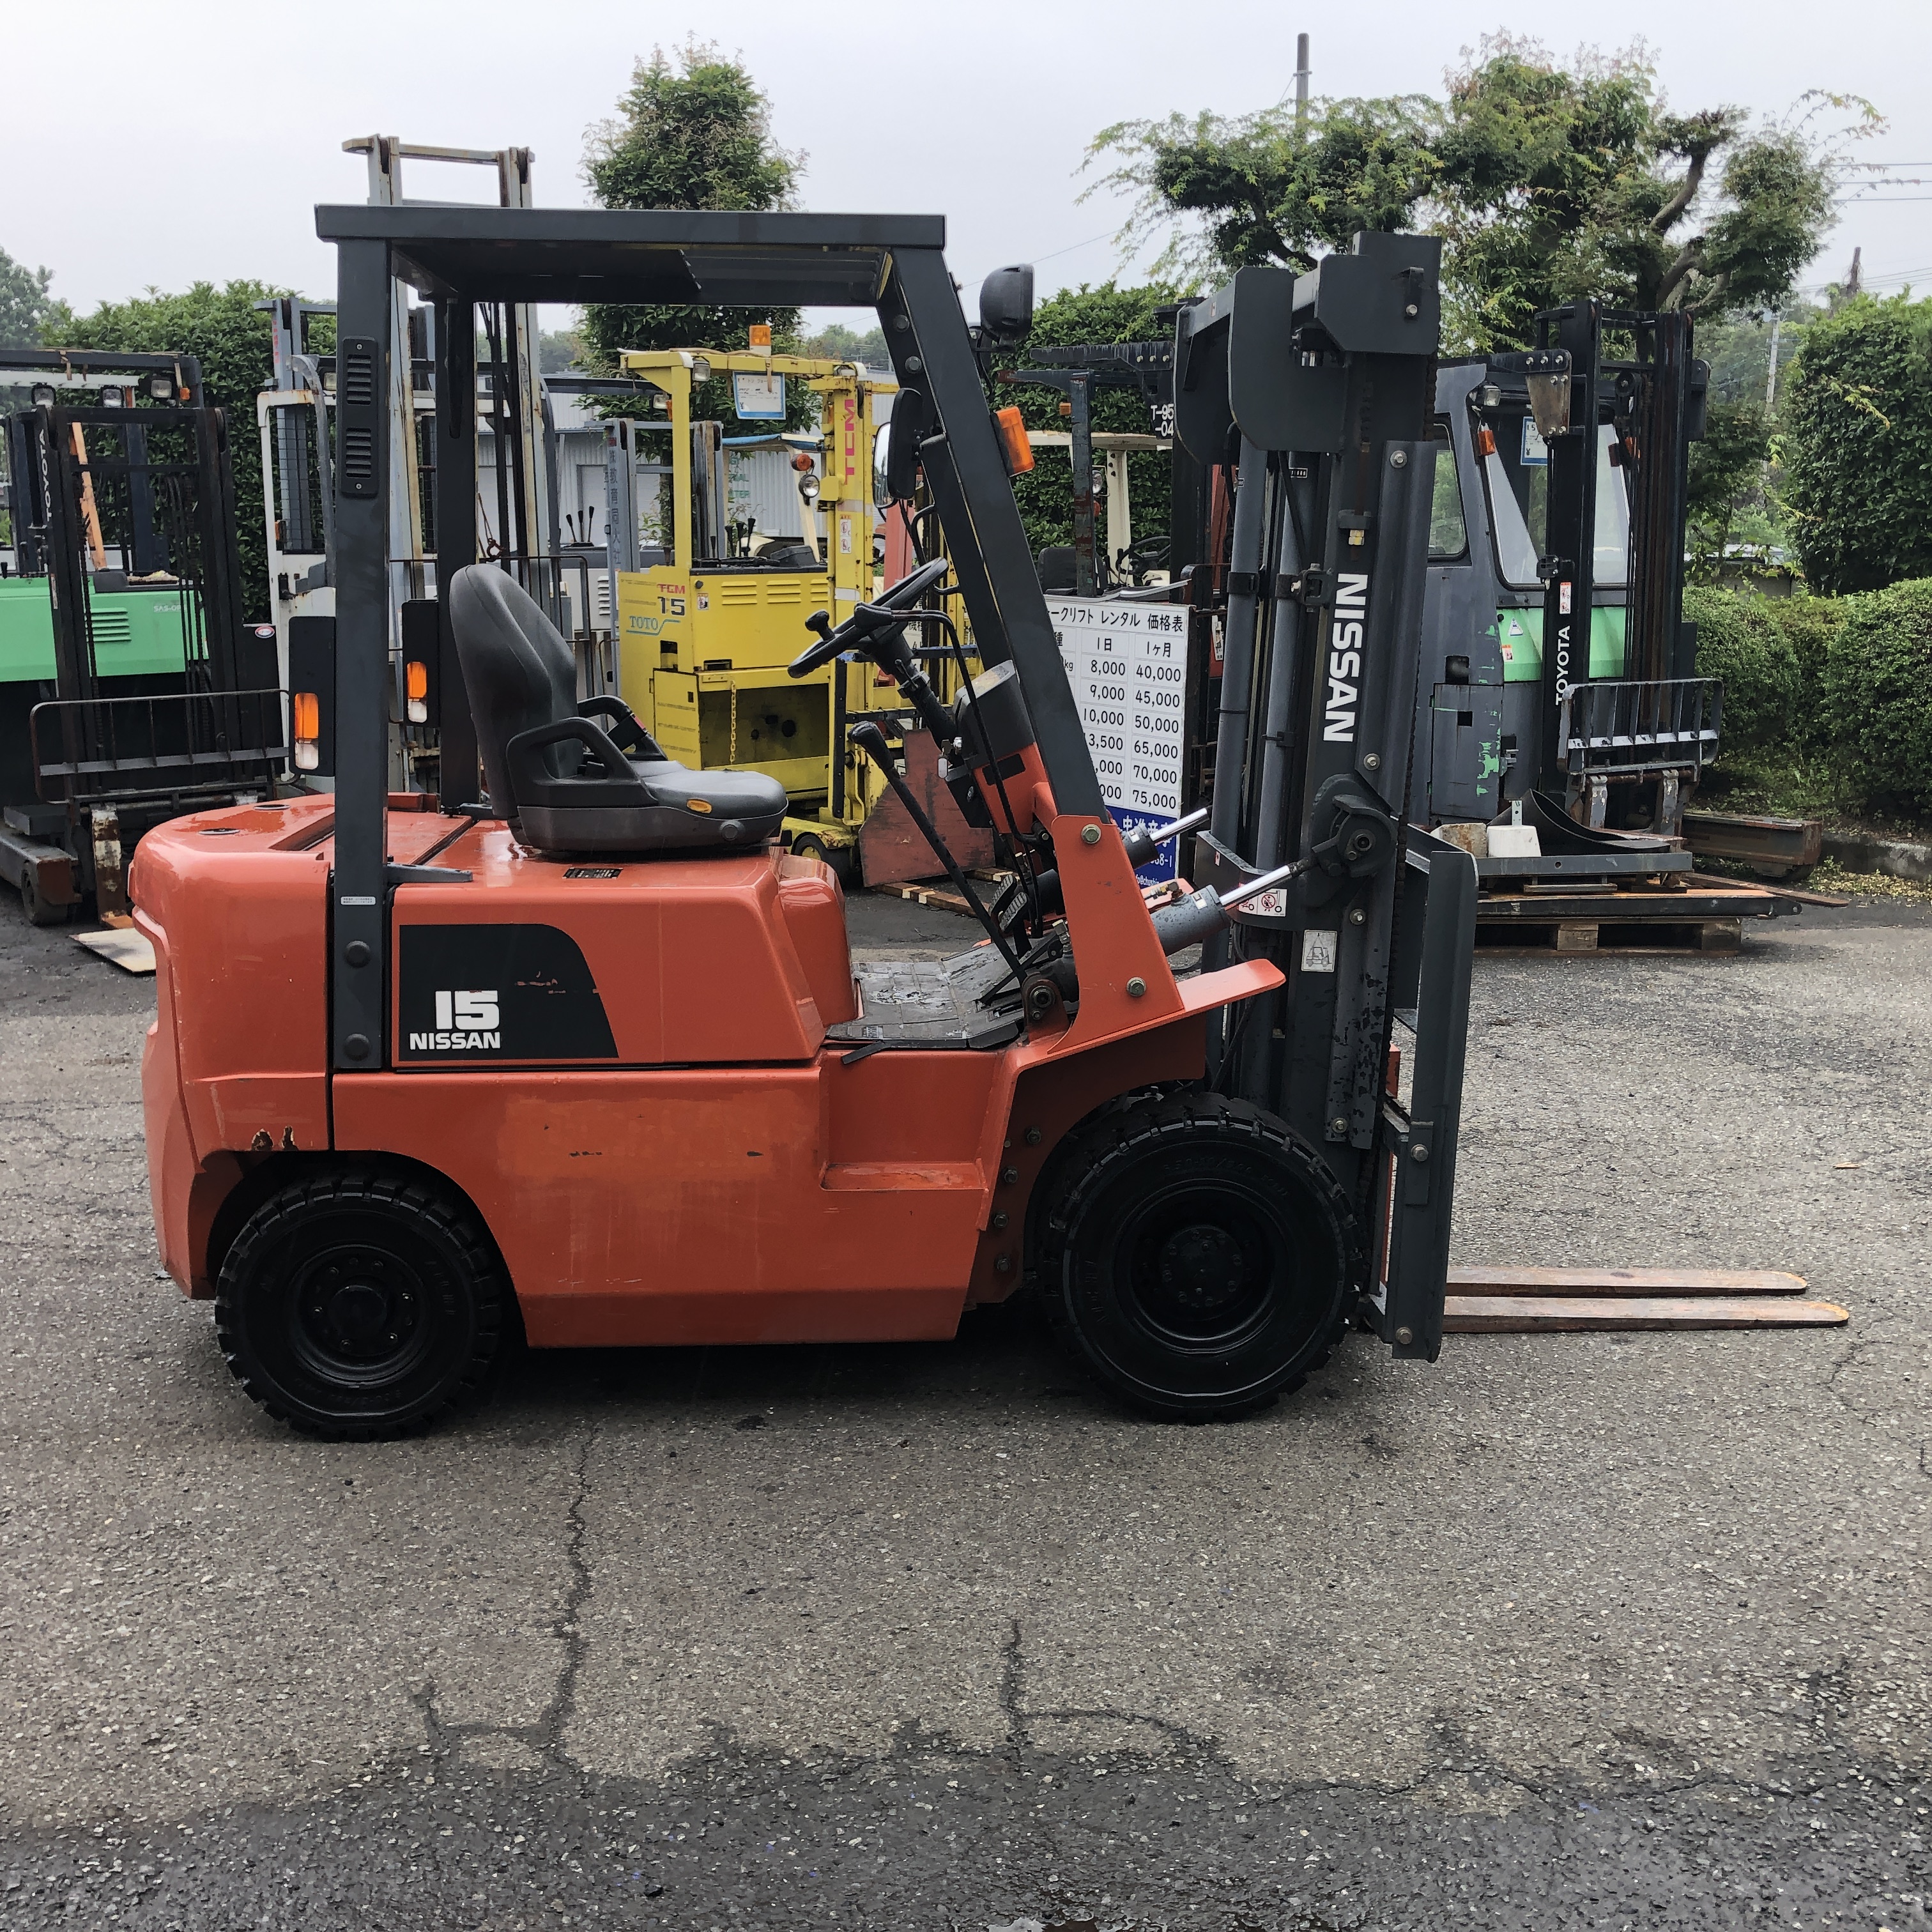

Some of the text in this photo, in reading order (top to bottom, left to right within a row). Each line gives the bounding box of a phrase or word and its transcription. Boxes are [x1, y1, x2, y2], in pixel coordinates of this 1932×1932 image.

[1151, 403, 1174, 420] T-95
[1154, 420, 1174, 437] -04
[844, 399, 855, 485] TCM
[39, 429, 52, 522] TOYOTA
[657, 583, 686, 595] TCM
[657, 596, 685, 616] 15
[629, 615, 659, 631] TOTO
[1047, 607, 1183, 632] ークリフト レンタル 価格表
[1054, 631, 1172, 658] 種 1日 1ヶ月
[1061, 655, 1181, 682] kg 8,000 40,000
[1322, 573, 1368, 742] NISSAN
[1555, 625, 1570, 706] TOYOTA
[1090, 684, 1180, 708] 9,000 45,000
[1084, 708, 1179, 733] 10,000 50,000
[1134, 740, 1178, 759] 65,000
[1094, 760, 1177, 785] ,000 70,000
[1099, 784, 1176, 809] 000 75,000
[435, 990, 500, 1030] 15
[410, 1031, 501, 1050] NISSAN
